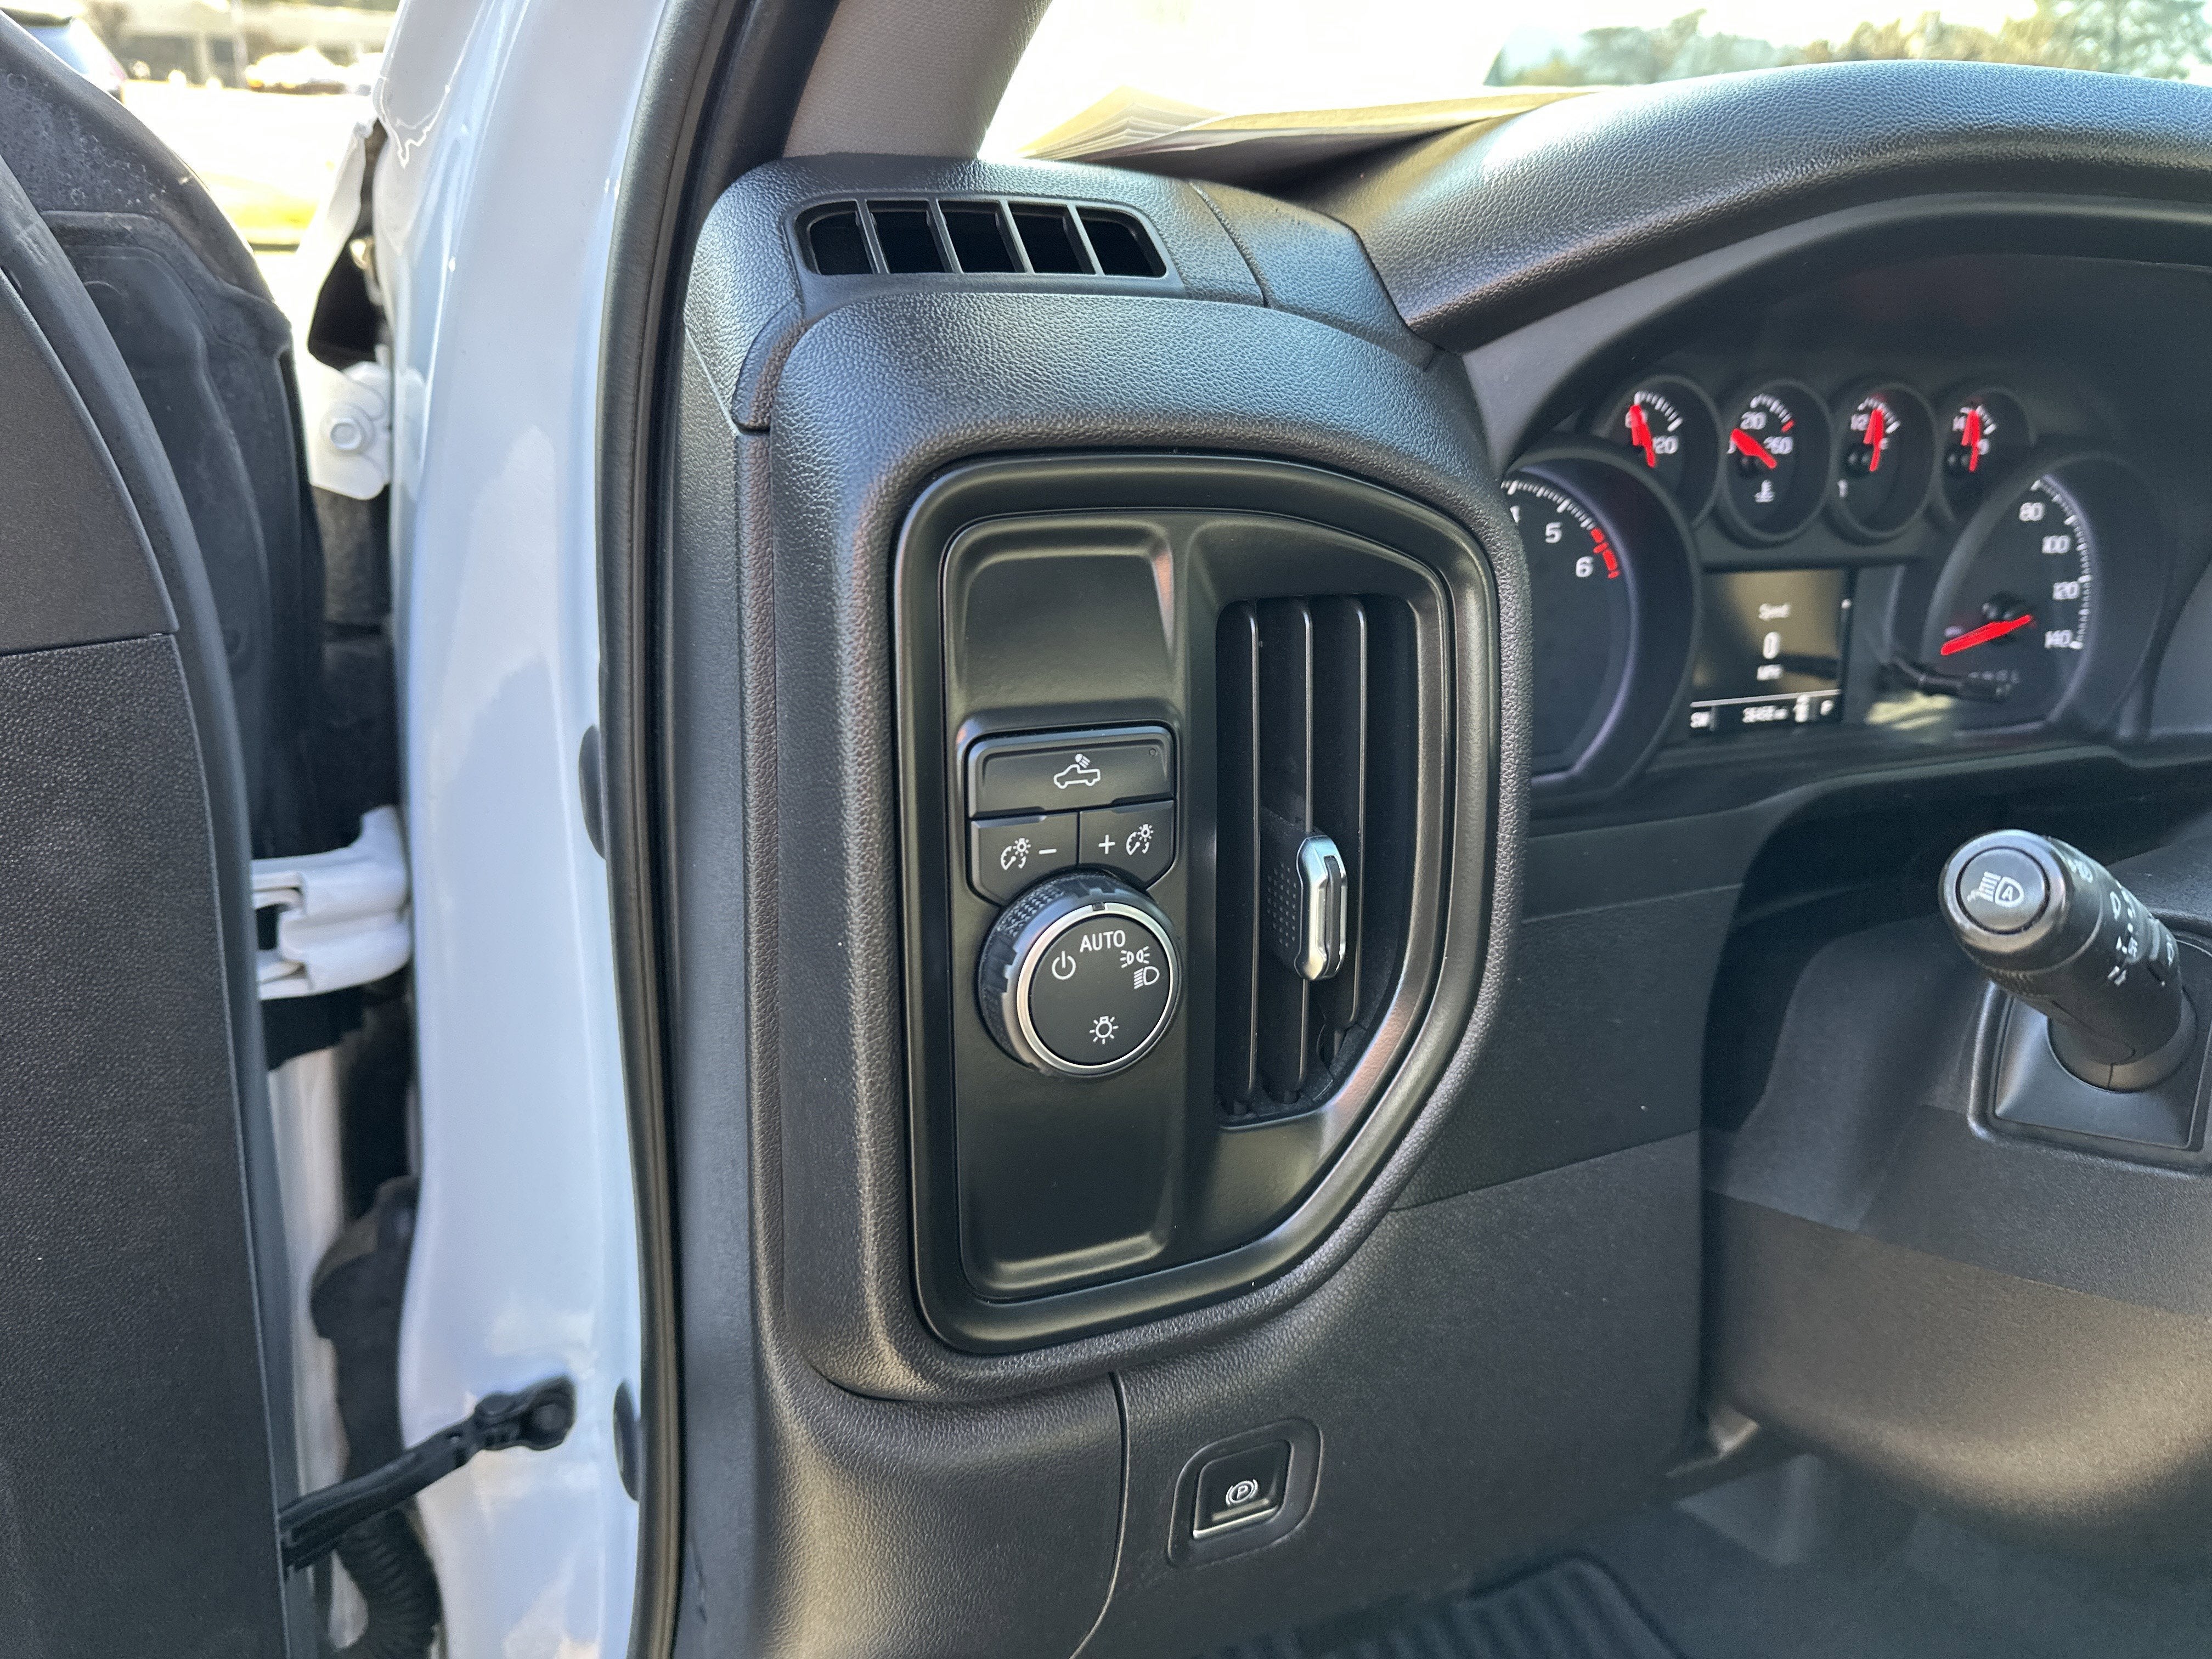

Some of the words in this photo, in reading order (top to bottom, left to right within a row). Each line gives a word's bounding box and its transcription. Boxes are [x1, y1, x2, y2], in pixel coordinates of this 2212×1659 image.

[1545, 522, 1563, 544] 5
[2042, 535, 2070, 554] 100
[1575, 556, 1594, 578] 6
[1763, 631, 1781, 659] 0
[2001, 884, 2013, 901] A
[1079, 929, 1126, 953] AUTO
[1237, 1485, 1249, 1499] P
